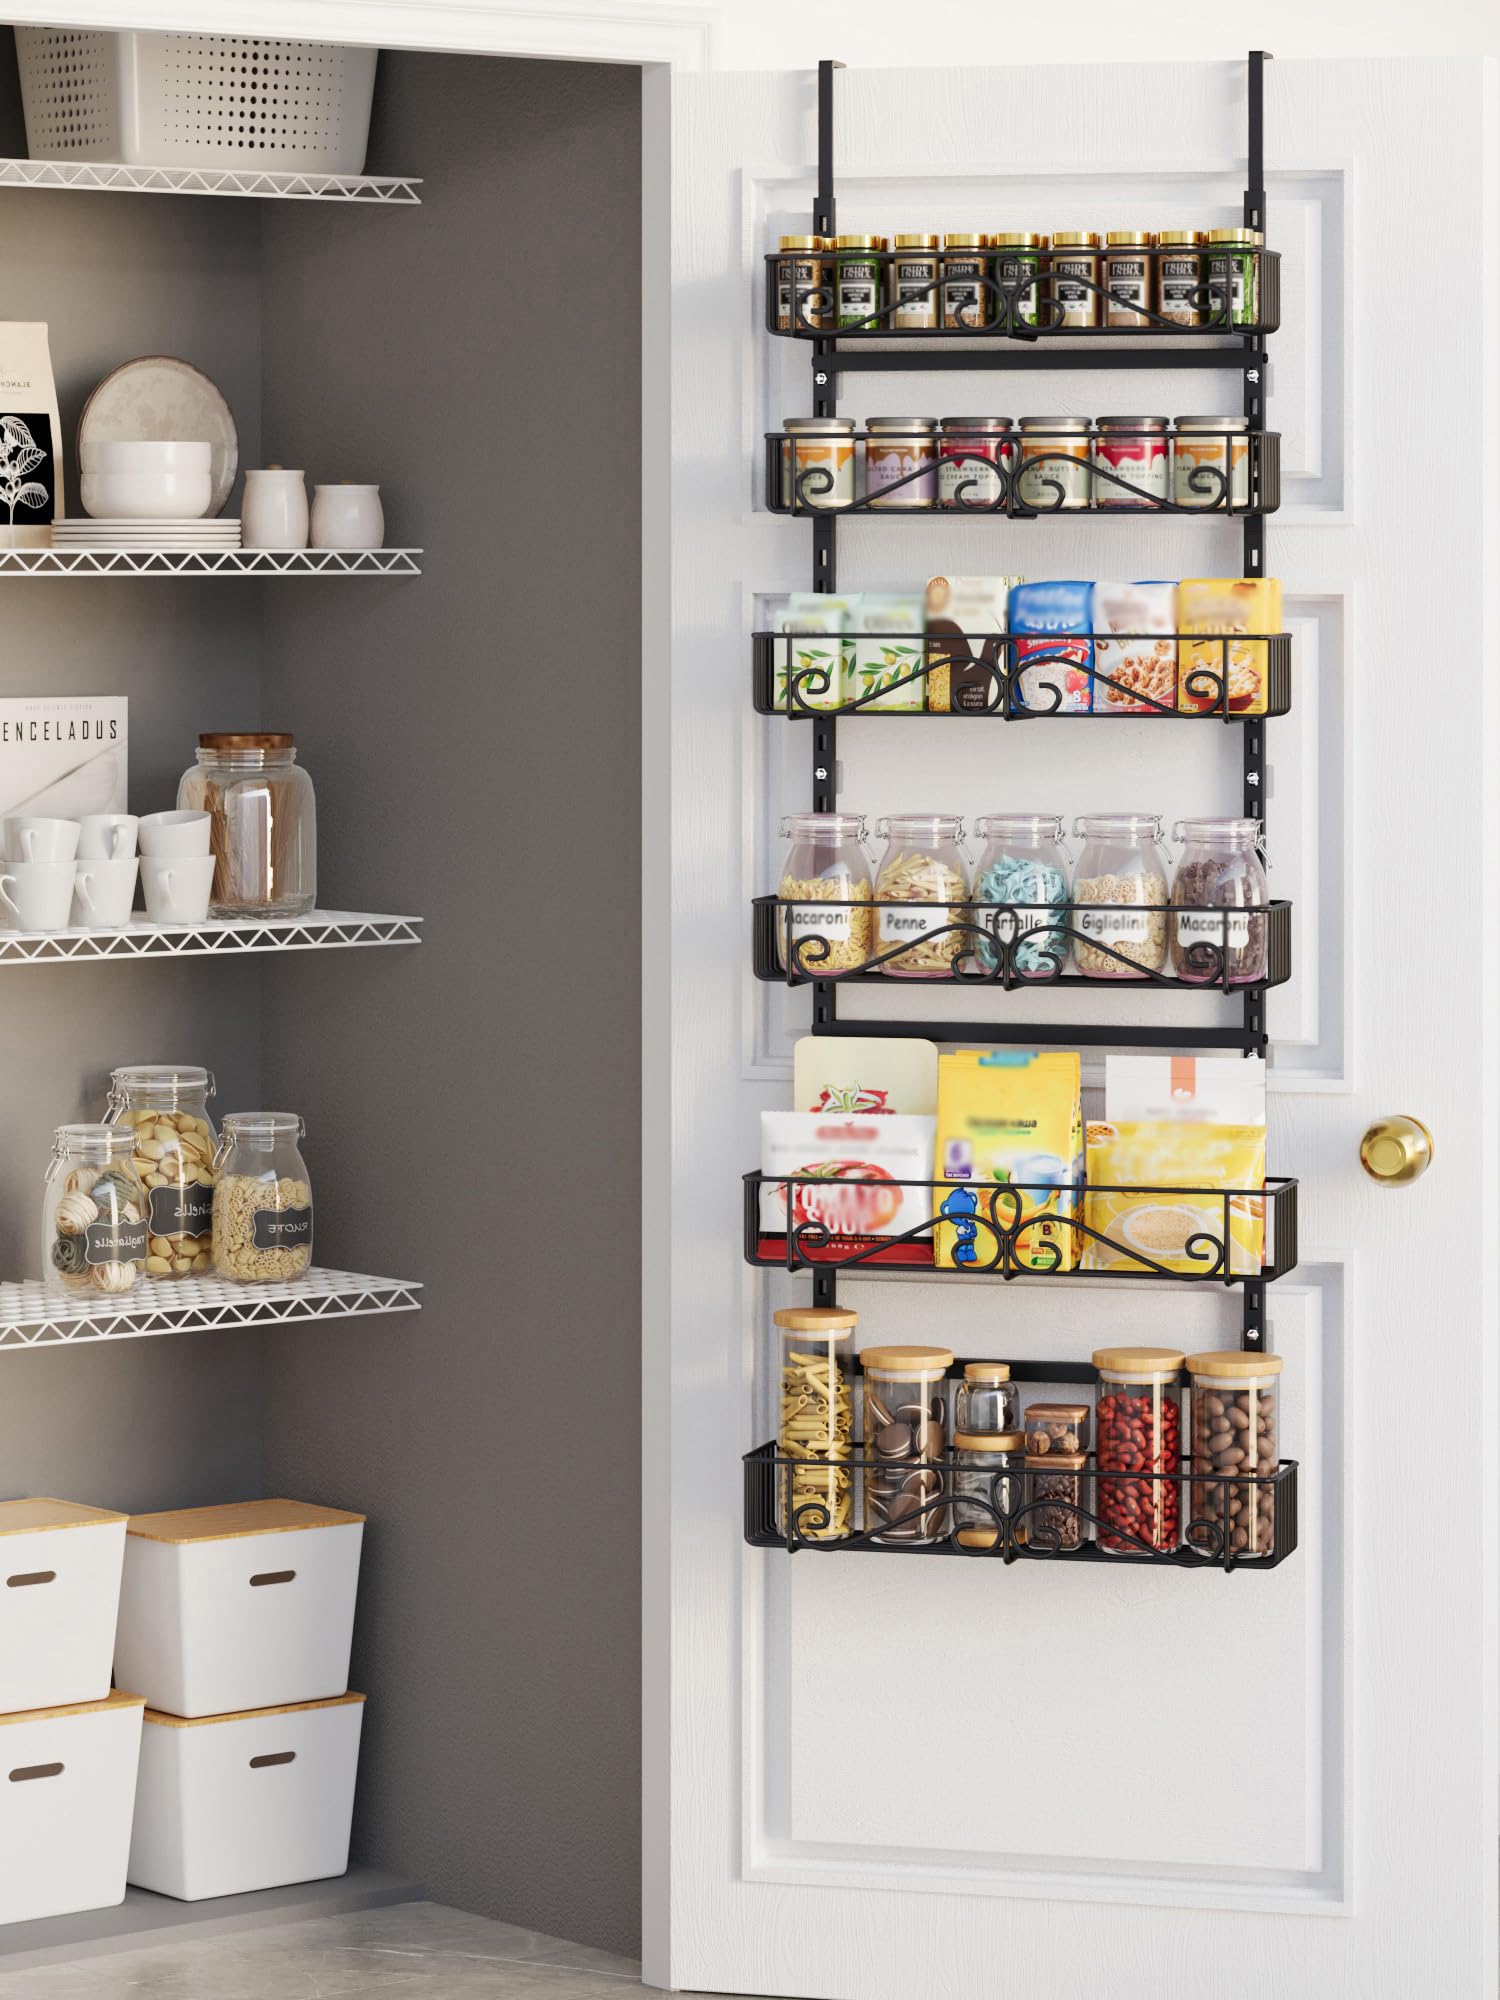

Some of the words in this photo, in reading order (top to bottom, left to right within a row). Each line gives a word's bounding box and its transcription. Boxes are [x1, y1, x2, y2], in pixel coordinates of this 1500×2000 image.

[1073, 690, 1081, 702] 8
[3, 719, 117, 742] ENCELADUS
[885, 913, 927, 931] Penne
